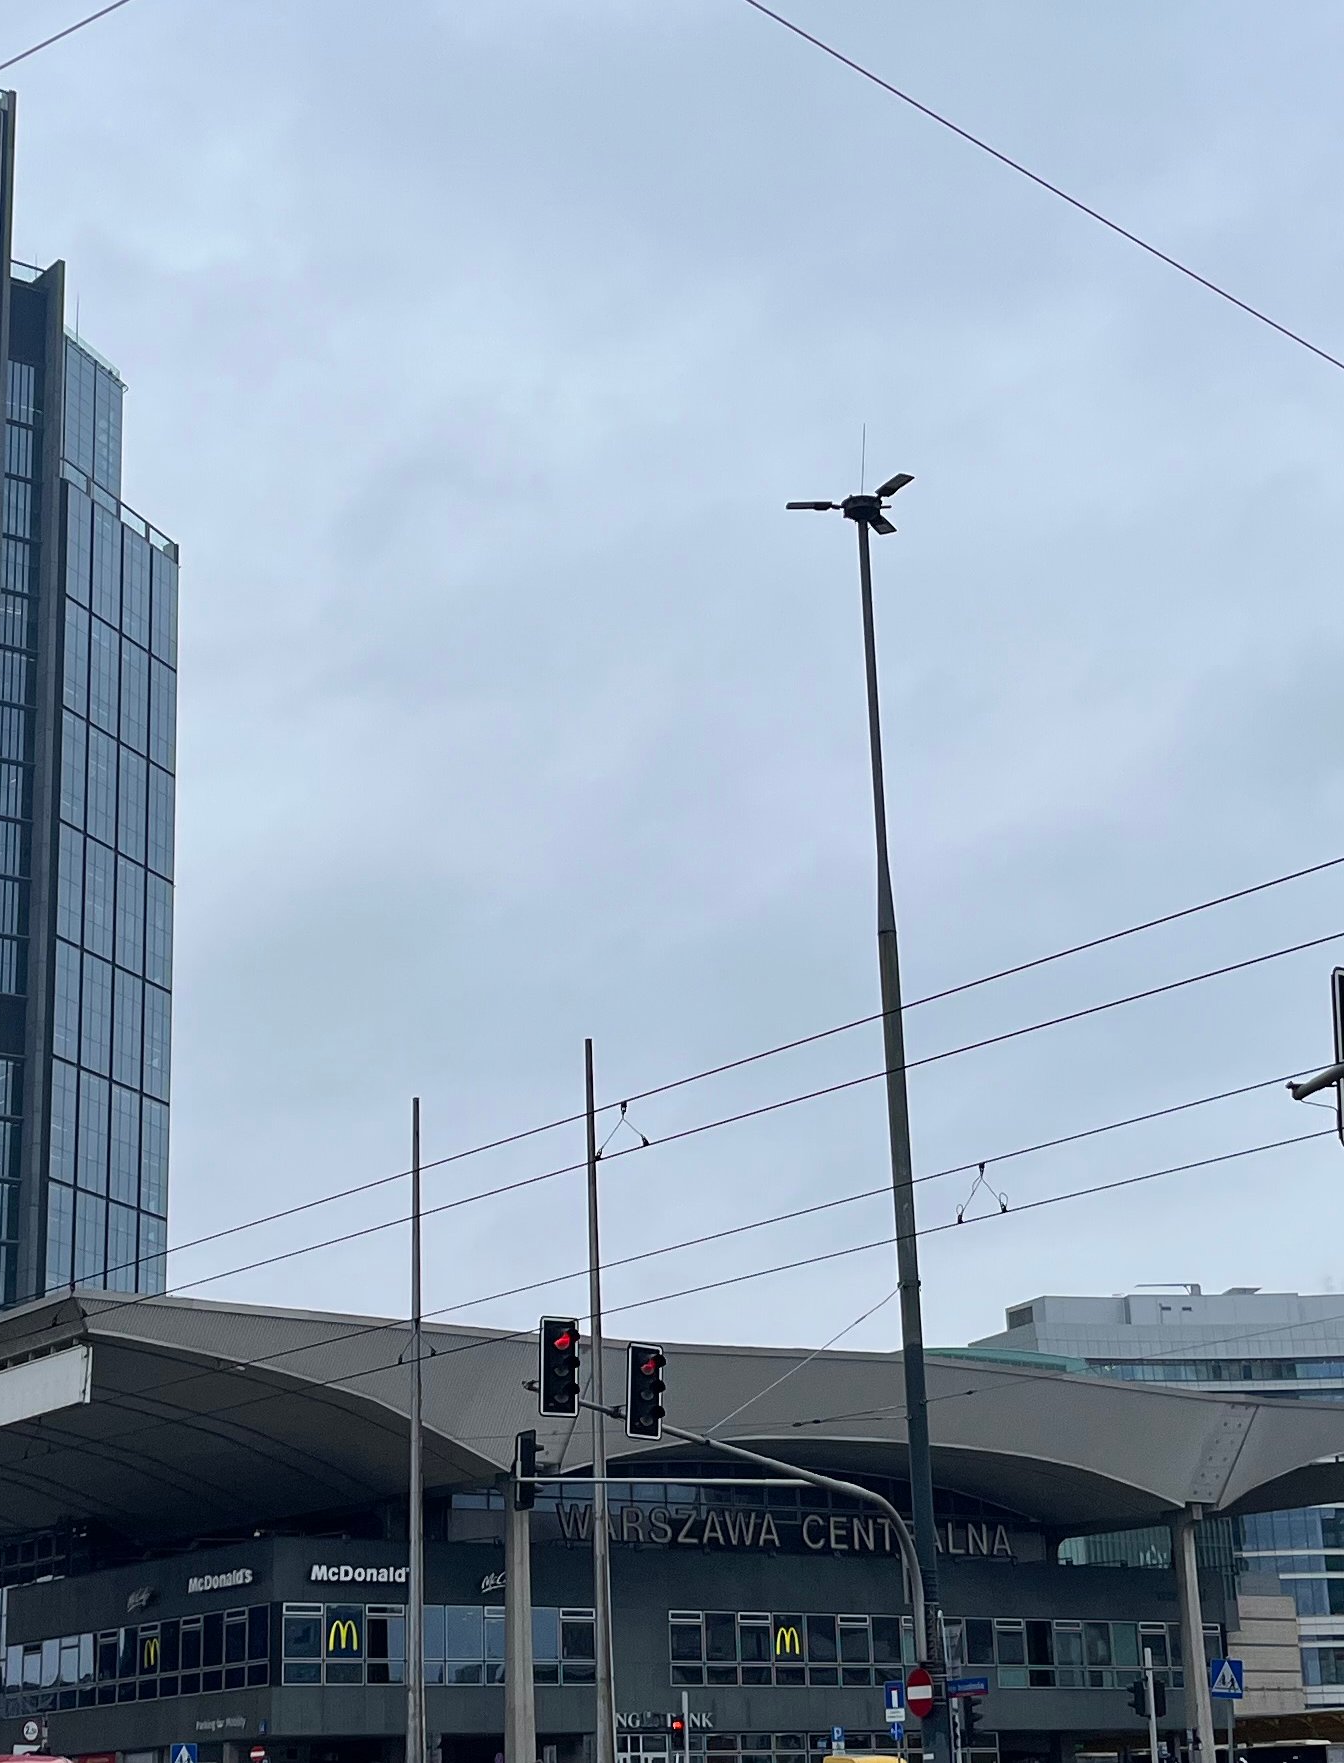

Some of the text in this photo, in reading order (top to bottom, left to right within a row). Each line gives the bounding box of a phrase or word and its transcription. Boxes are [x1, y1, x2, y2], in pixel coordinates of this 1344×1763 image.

[188, 1568, 253, 1594] McDonald's
[310, 1564, 410, 1583] McDonald'
[833, 1729, 842, 1741] P
